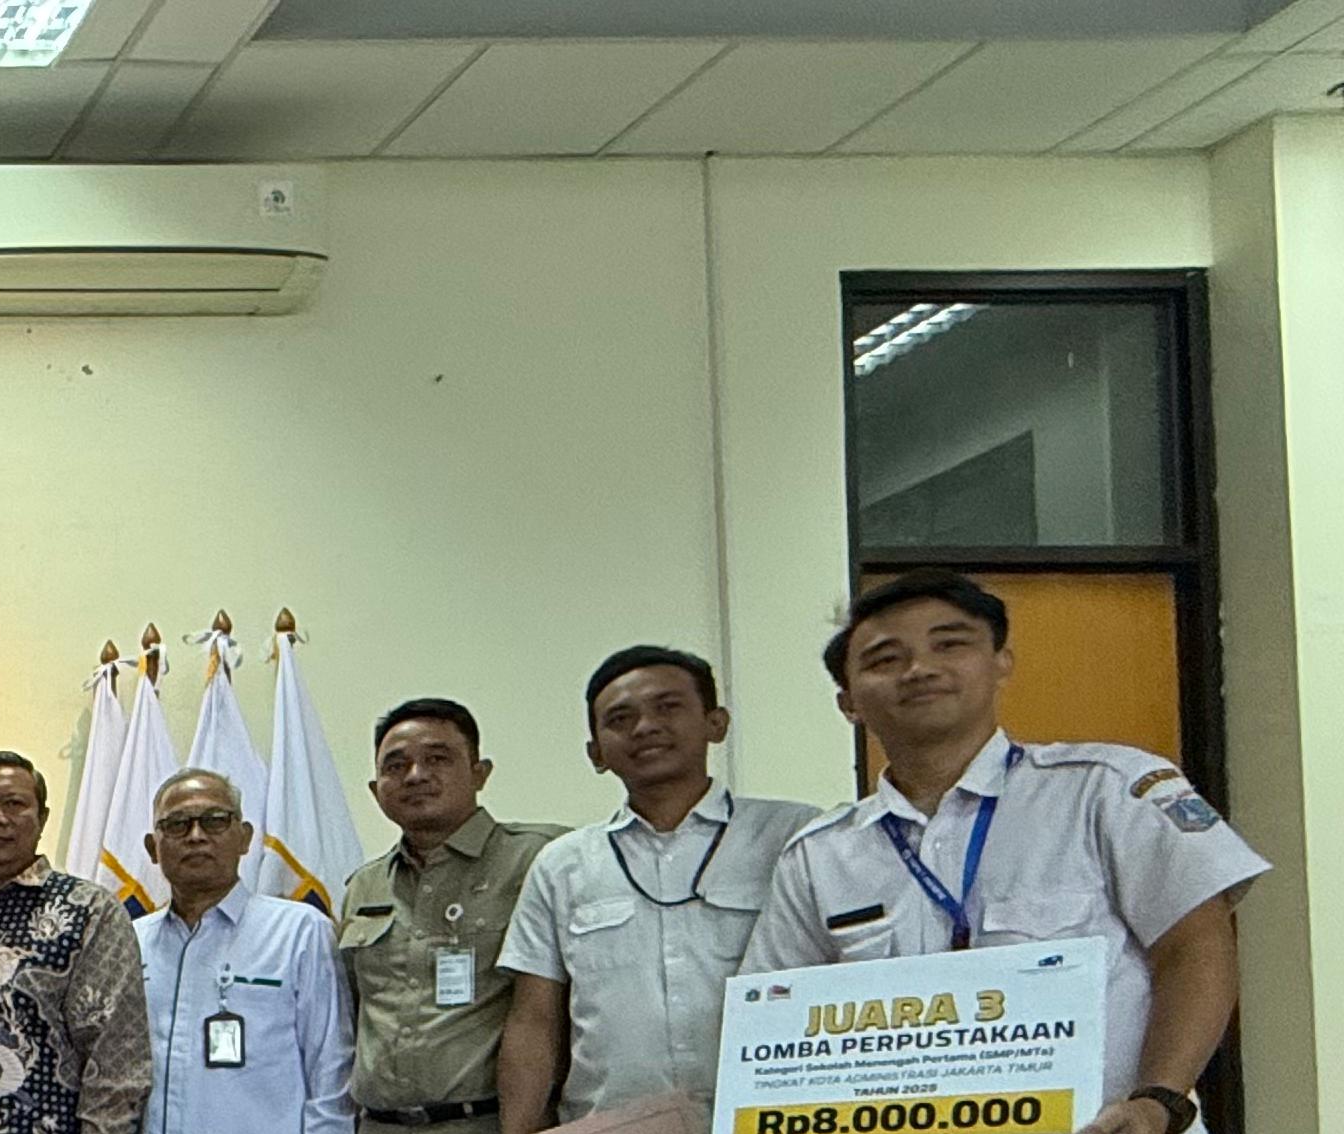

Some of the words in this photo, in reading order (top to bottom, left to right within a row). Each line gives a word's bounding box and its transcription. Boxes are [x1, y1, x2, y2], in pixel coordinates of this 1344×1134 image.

[804, 992, 960, 1037] JUARA
[975, 989, 1006, 1022] 3
[740, 1040, 832, 1063] LOMBA
[841, 1020, 1076, 1054] PERPUSTAKAAN
[854, 1085, 899, 1096] TAHUN
